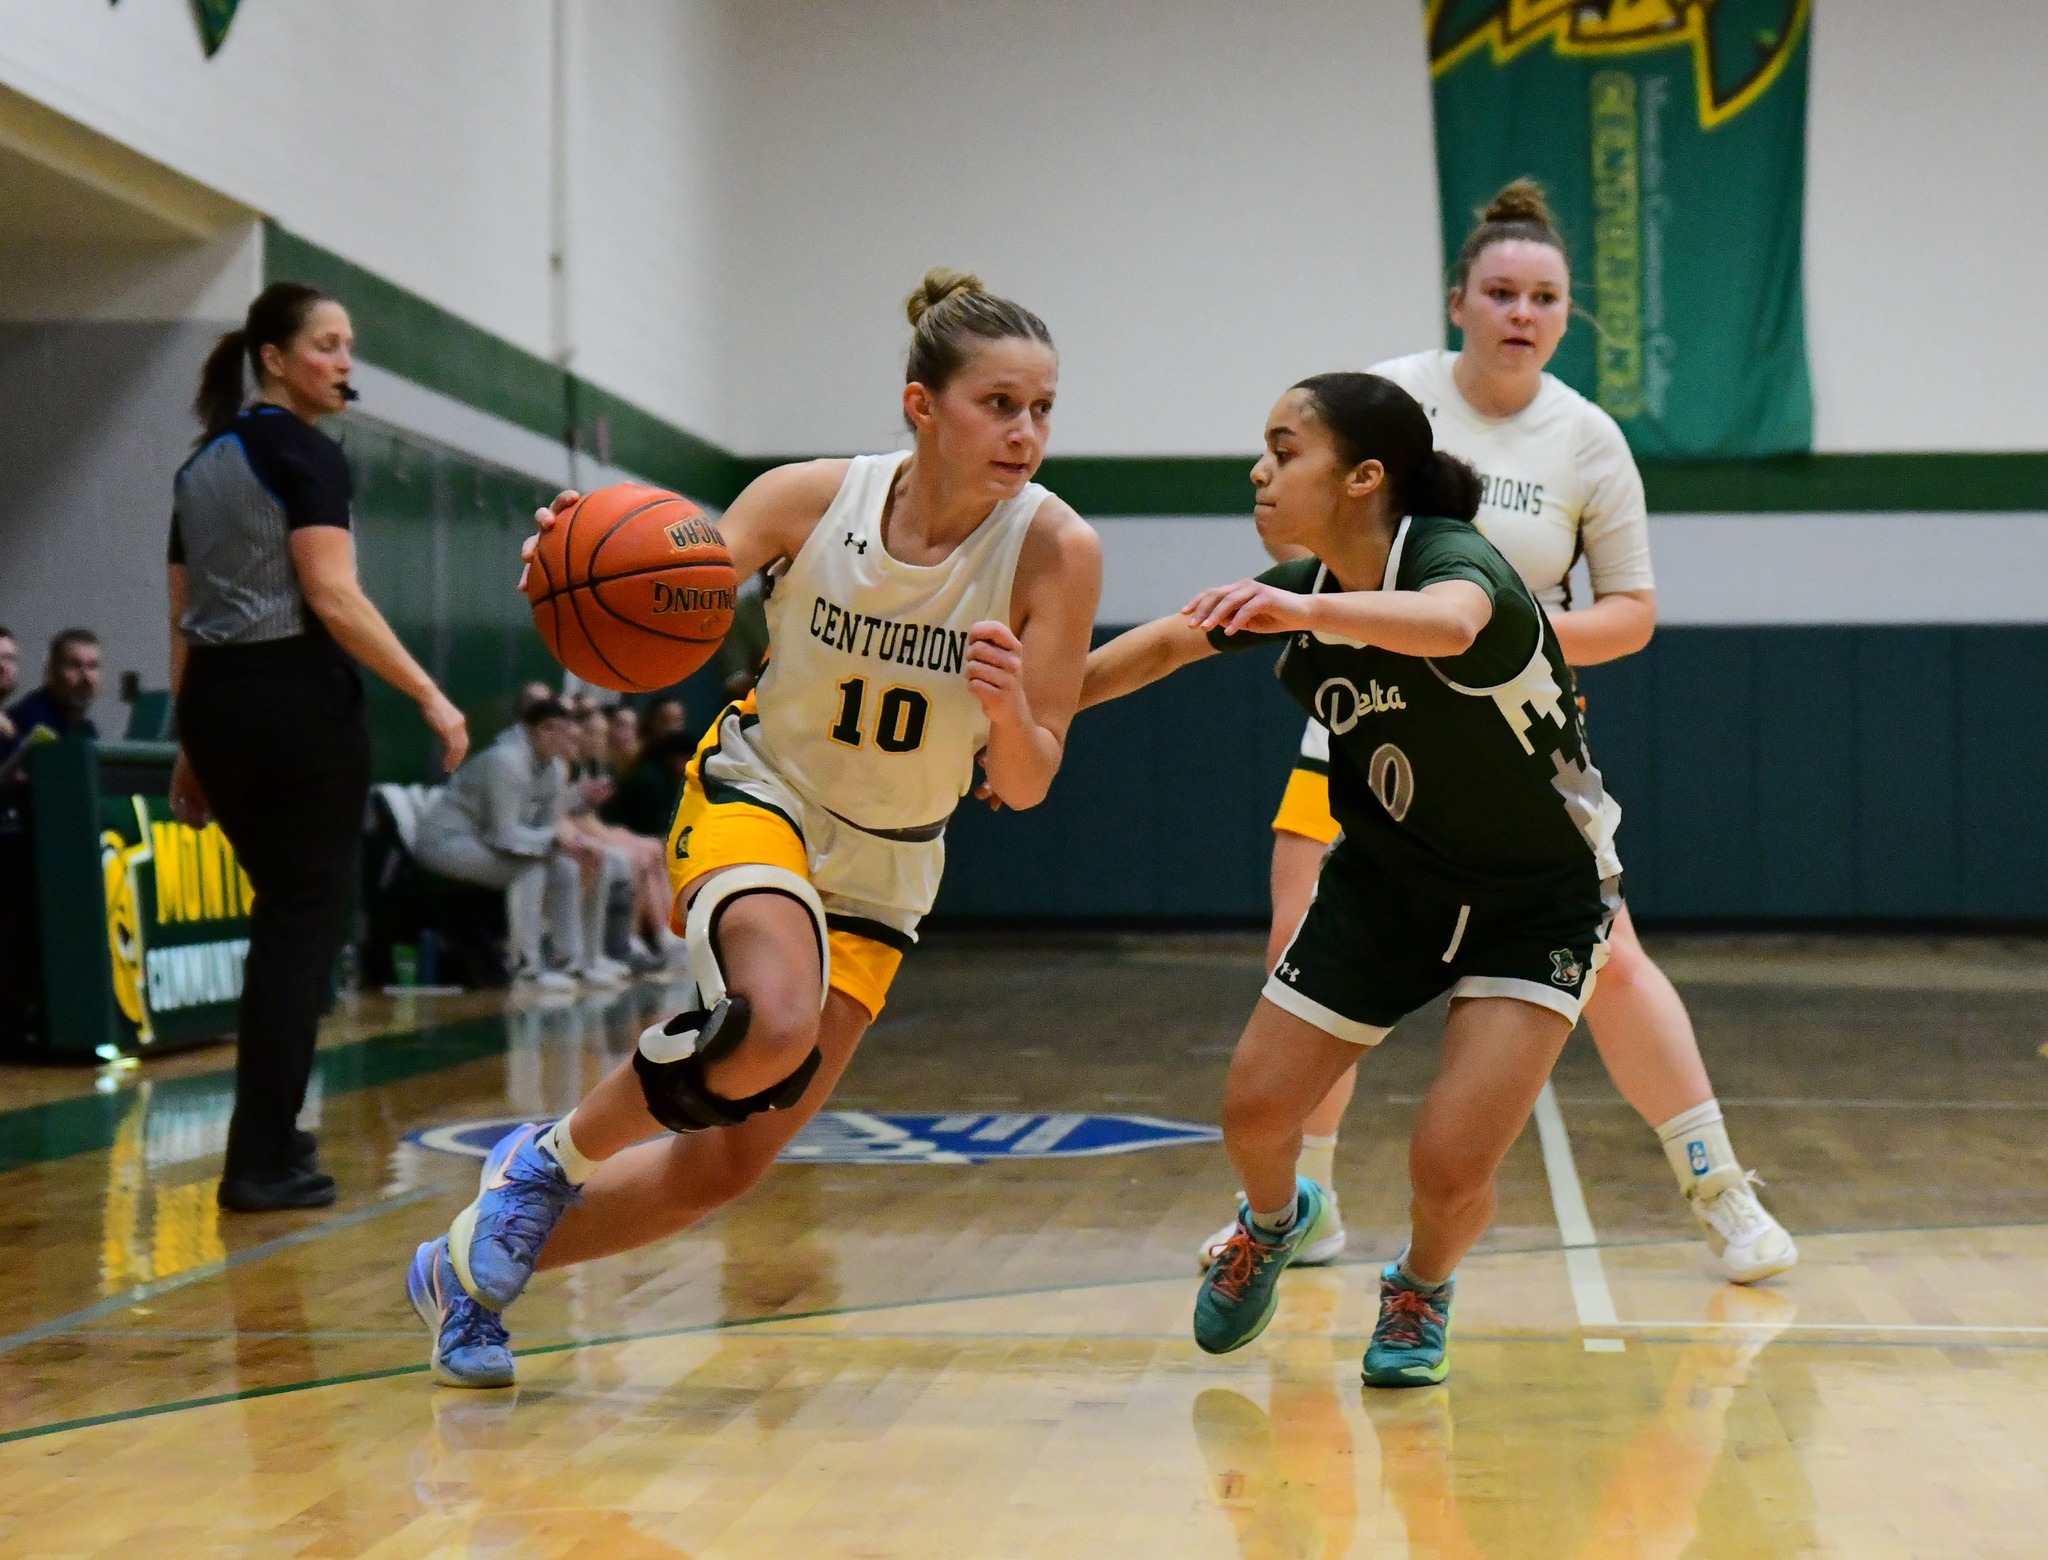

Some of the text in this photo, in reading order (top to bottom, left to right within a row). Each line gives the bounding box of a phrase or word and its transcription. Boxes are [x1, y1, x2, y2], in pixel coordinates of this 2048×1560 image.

[1480, 475, 1543, 515] RIONS
[652, 582, 738, 614] PALDING
[810, 596, 968, 674] CENTURION
[828, 674, 932, 755] 10
[1314, 676, 1407, 736] Delta
[1367, 742, 1414, 822] 0
